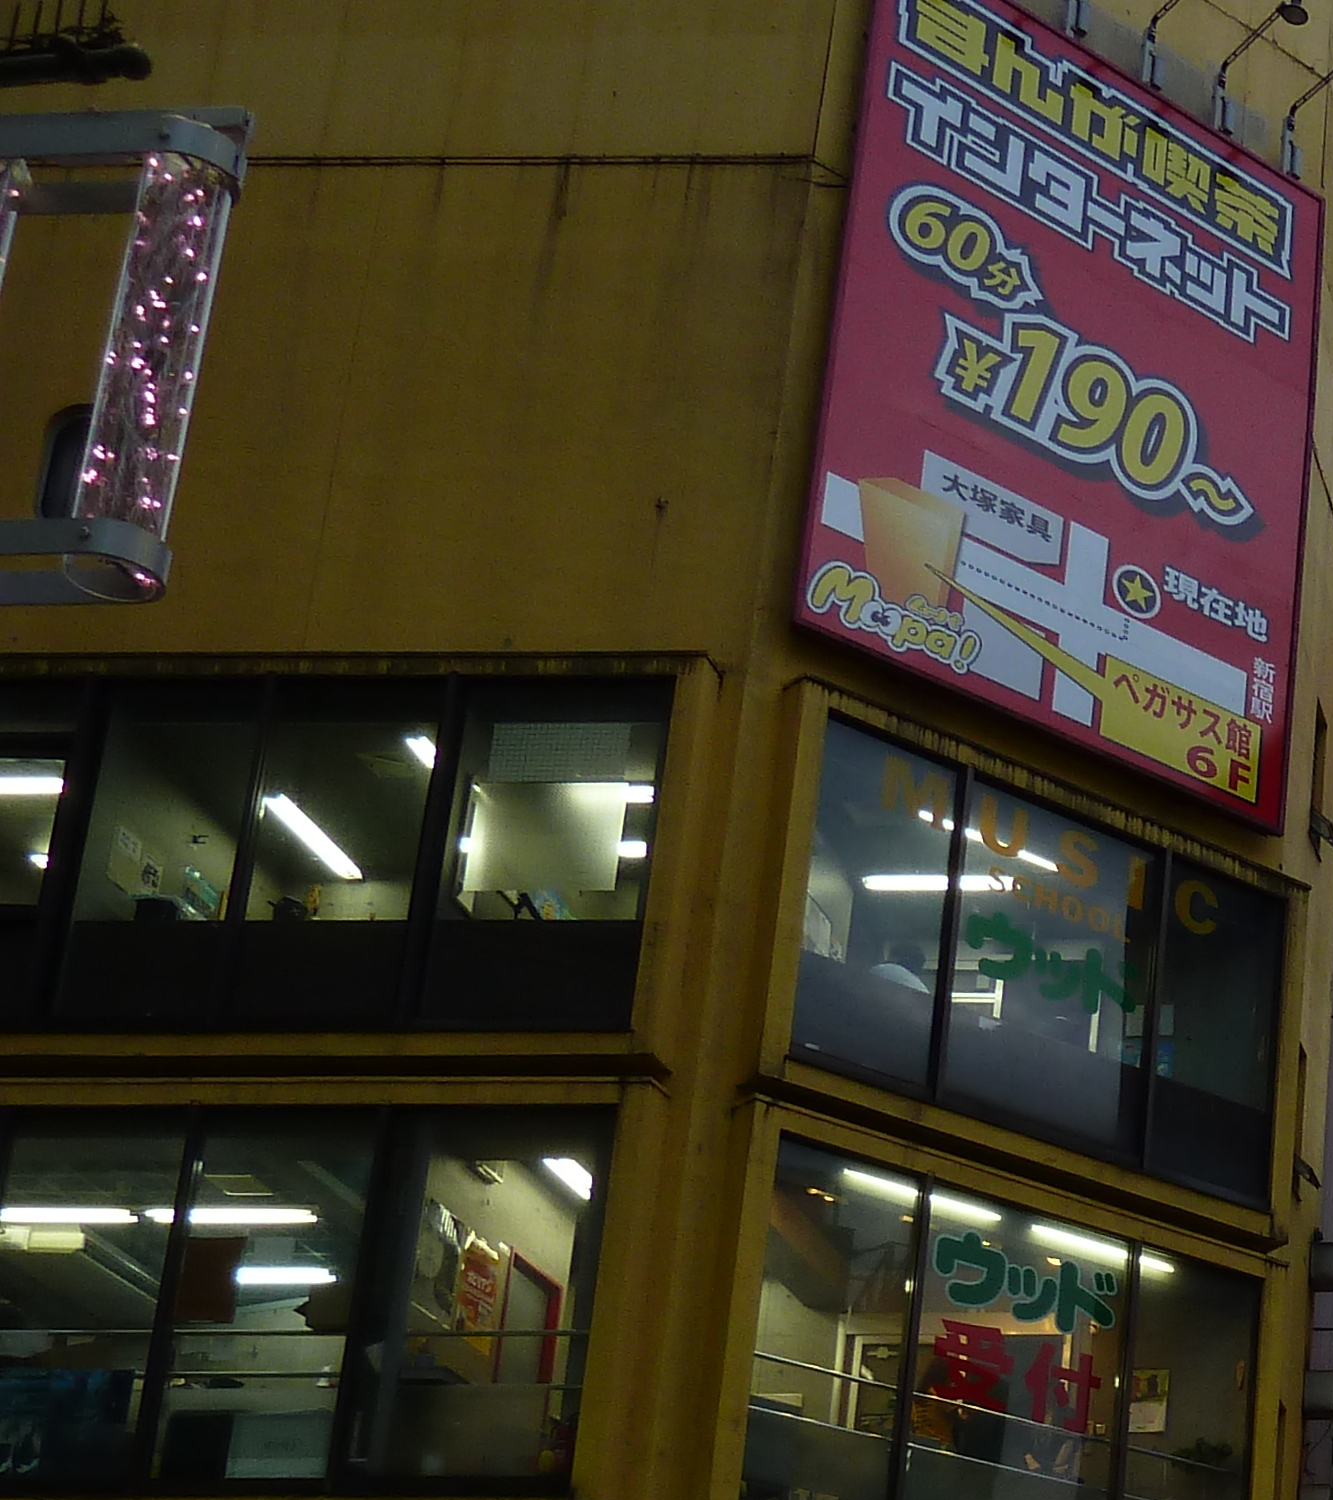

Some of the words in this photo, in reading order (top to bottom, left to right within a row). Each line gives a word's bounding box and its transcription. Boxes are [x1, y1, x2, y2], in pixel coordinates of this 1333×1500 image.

[896, 76, 1288, 336] インターネット
[902, 198, 1022, 297] 60分
[940, 471, 1055, 545] 大塚家具
[1162, 563, 1269, 643] 現在地
[1111, 672, 1254, 762] ペガサス館
[1250, 656, 1276, 725] 新宿駅
[1186, 741, 1253, 793] 6F
[964, 911, 1138, 1015] ウッド
[932, 1231, 1118, 1332] ウッド
[934, 1318, 1102, 1435] 受付
